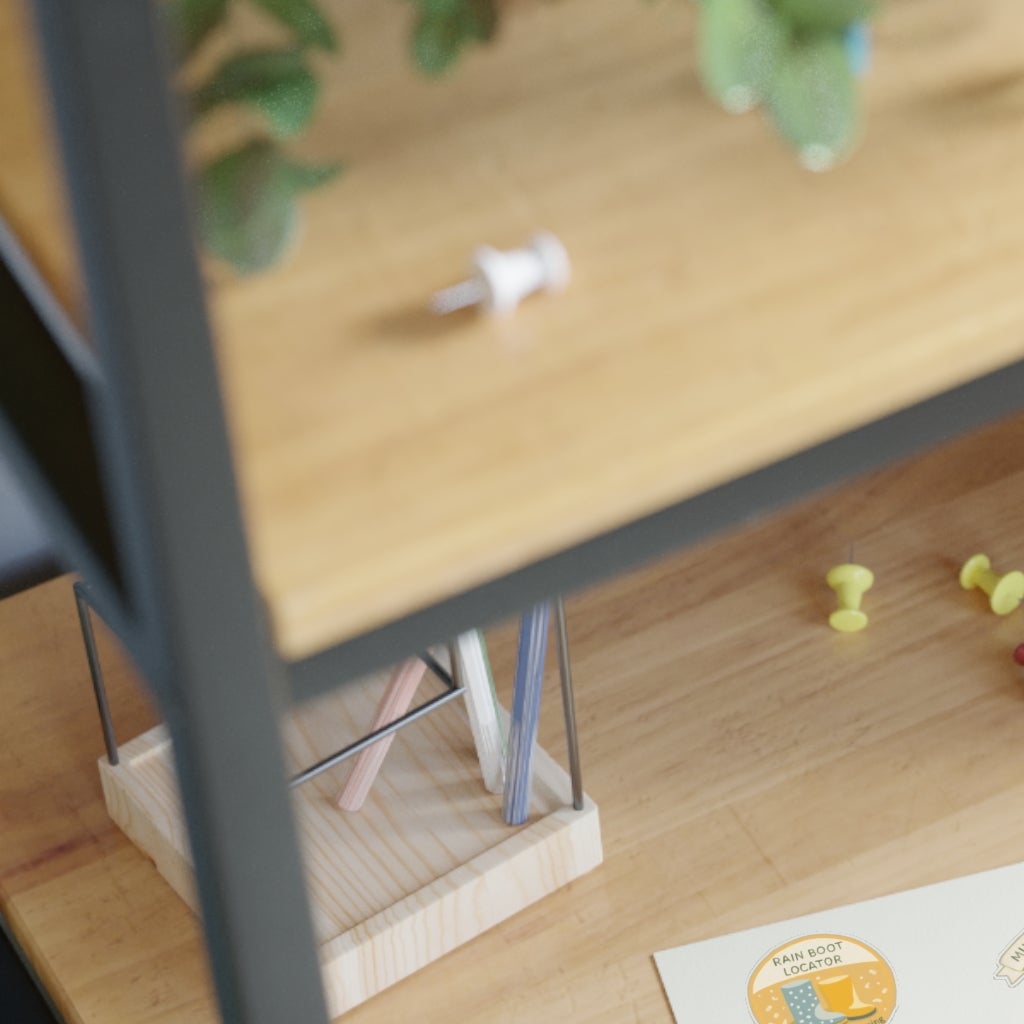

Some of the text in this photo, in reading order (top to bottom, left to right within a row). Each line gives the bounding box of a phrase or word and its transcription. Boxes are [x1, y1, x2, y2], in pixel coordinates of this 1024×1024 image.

[772, 941, 844, 967] RAIN BOOT
[783, 955, 843, 976] LOCATOR
